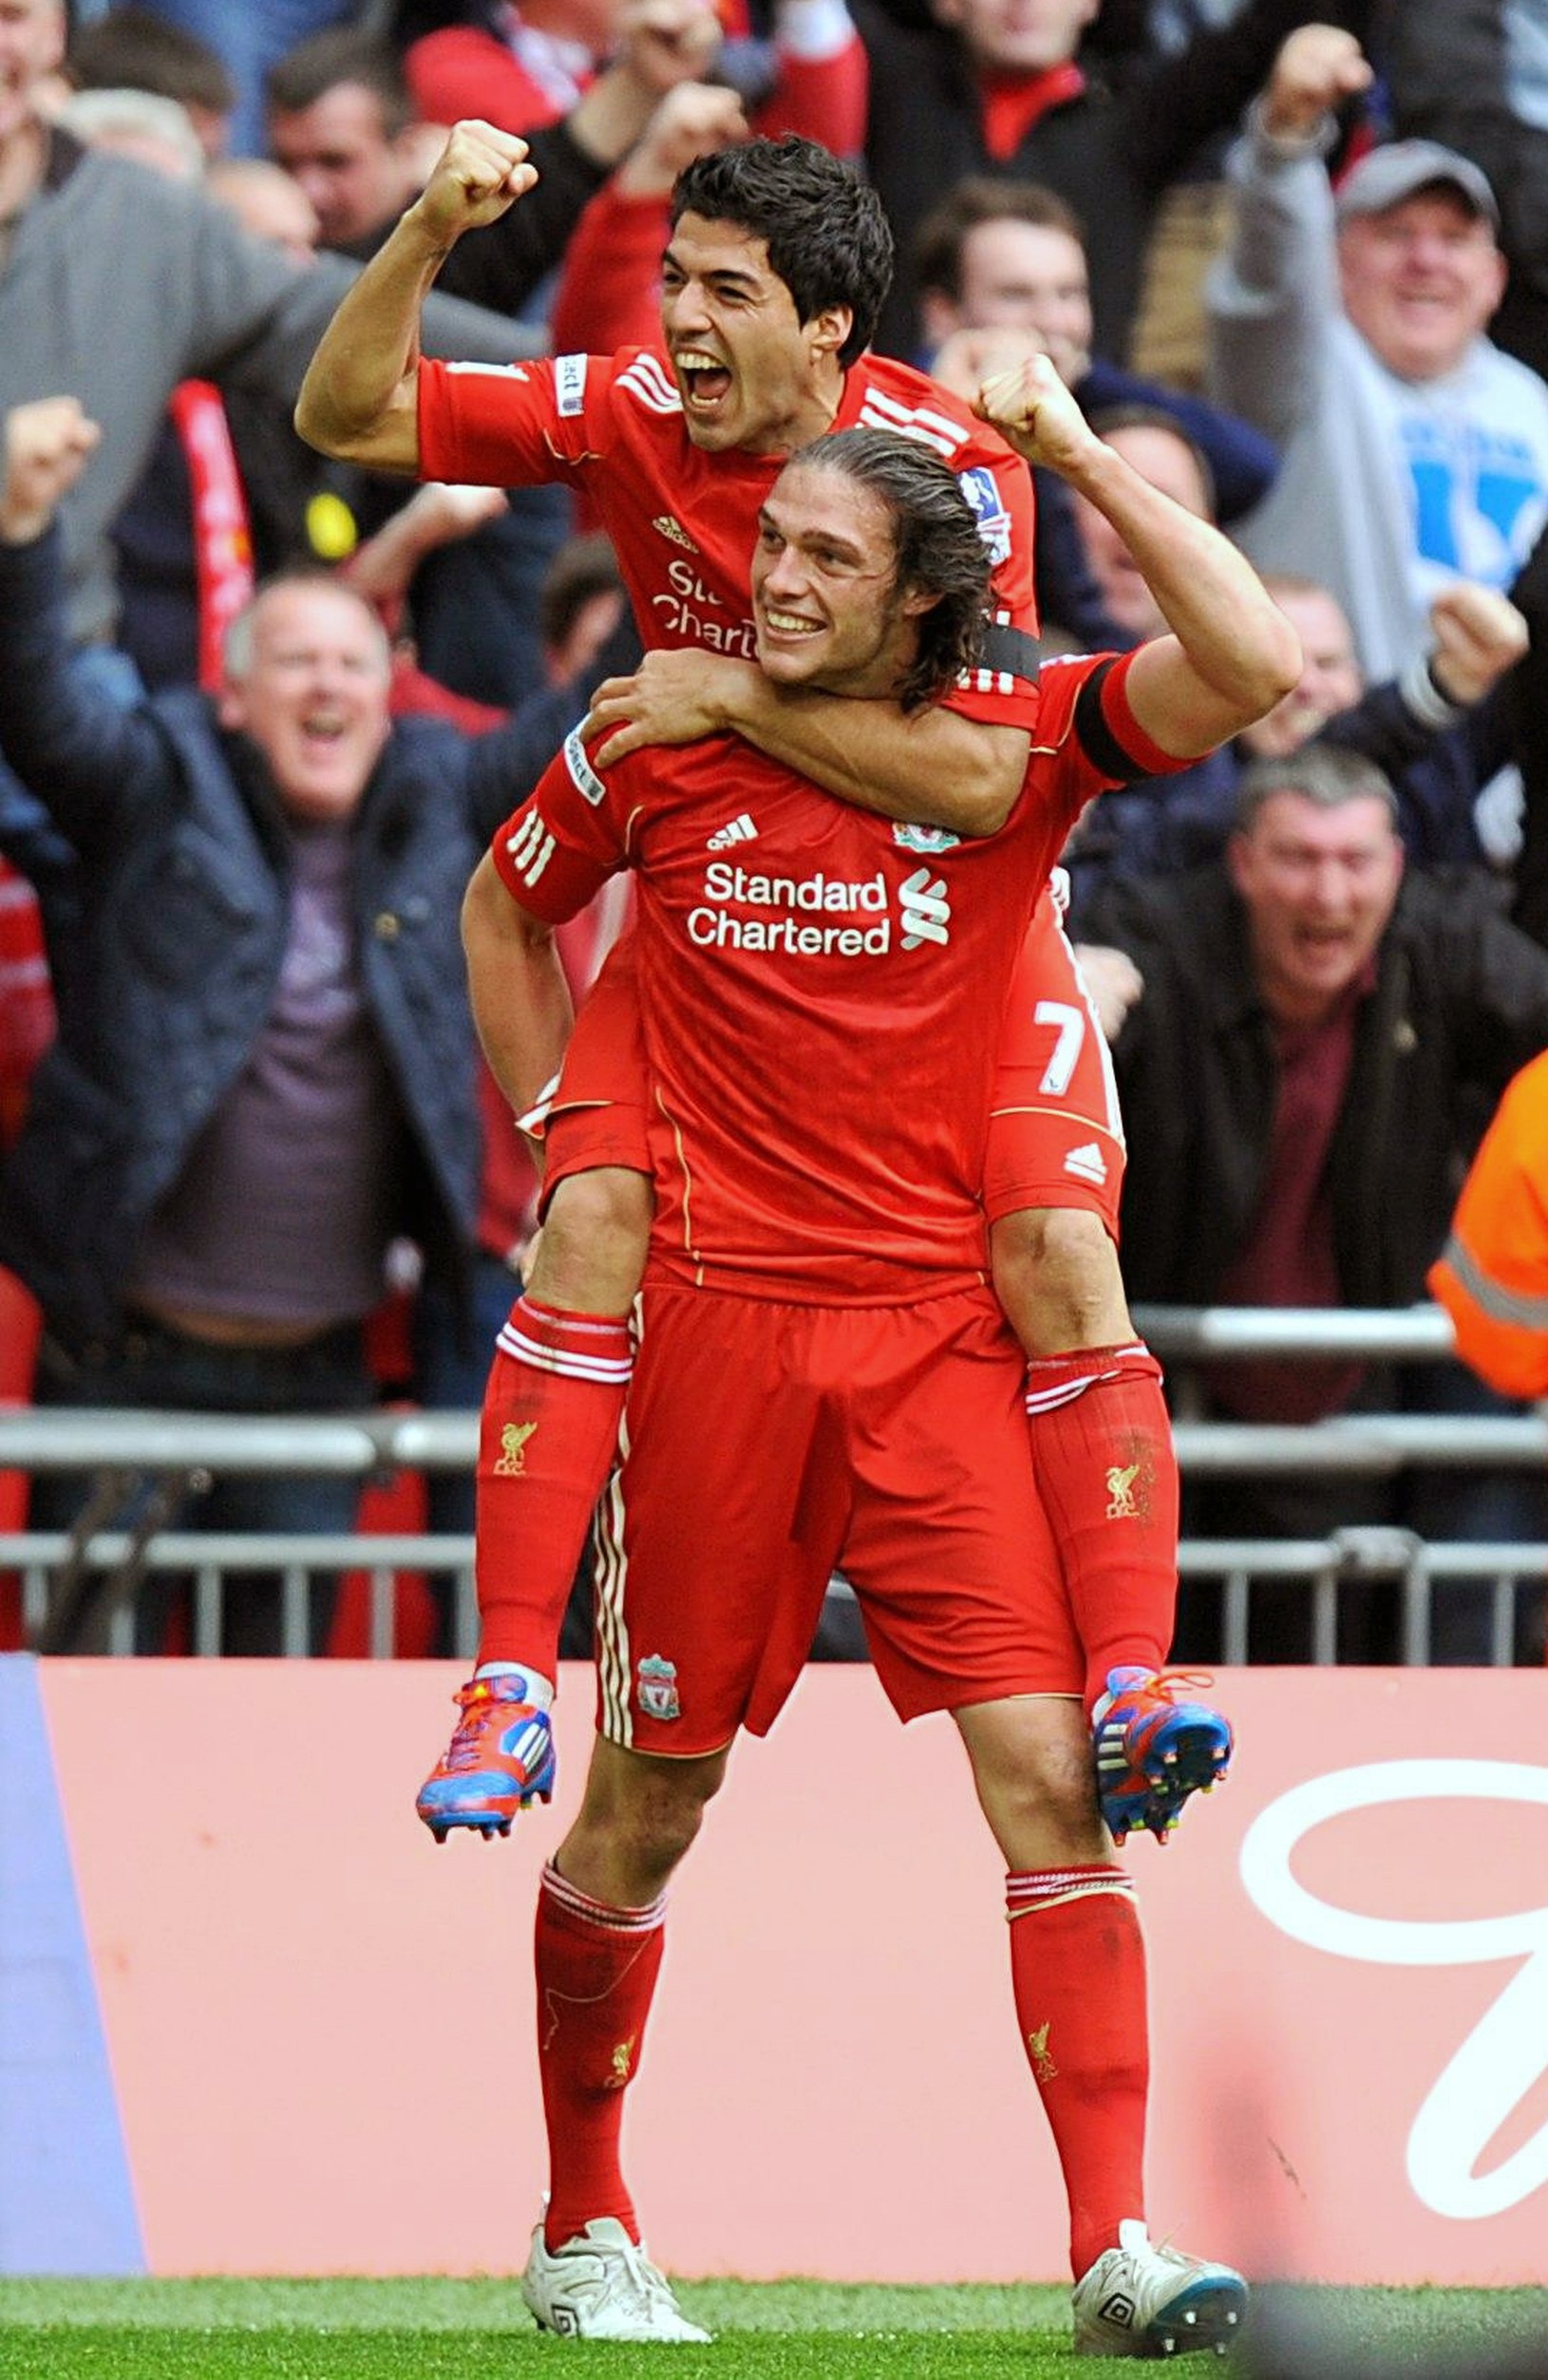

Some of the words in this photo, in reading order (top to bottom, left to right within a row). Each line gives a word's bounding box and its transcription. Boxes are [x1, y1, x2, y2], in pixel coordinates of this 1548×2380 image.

[652, 594, 756, 658] Chart
[705, 862, 888, 912] Standard
[688, 907, 891, 956] Chartered
[1033, 1000, 1085, 1097] 7
